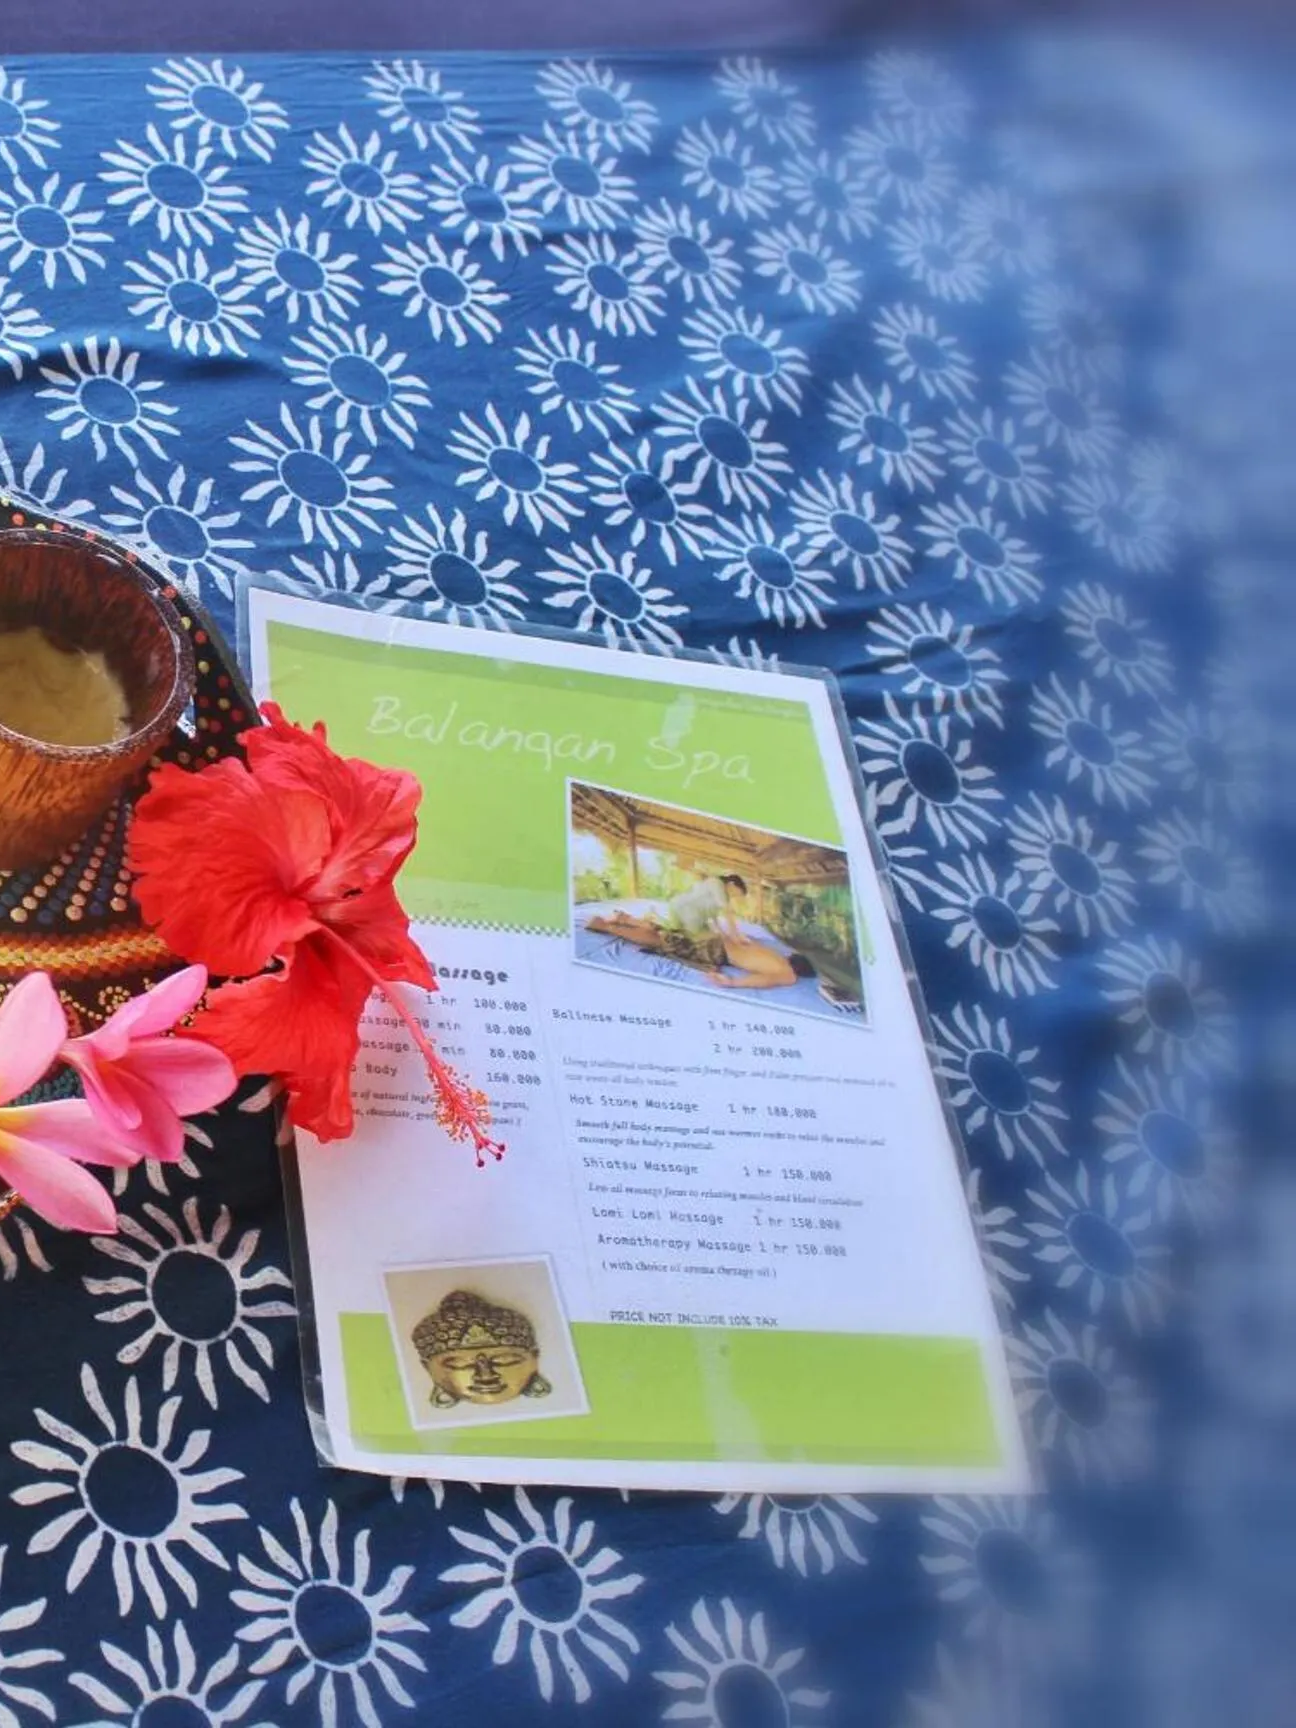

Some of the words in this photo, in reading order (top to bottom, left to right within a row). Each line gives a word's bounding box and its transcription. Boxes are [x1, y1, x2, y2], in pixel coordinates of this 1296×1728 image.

[365, 695, 617, 771] Balangan
[644, 732, 755, 788] Spa
[552, 1009, 613, 1022] Balinese
[619, 1014, 673, 1029] Massage
[359, 1040, 411, 1053] assage
[569, 1094, 594, 1105] Hot
[600, 1095, 638, 1108] Stone
[645, 1099, 700, 1113] Massage
[583, 1157, 637, 1171] Shiatsu
[644, 1160, 699, 1175] Massage
[592, 1206, 624, 1219] Lomi
[632, 1208, 662, 1220] Lomi
[669, 1210, 724, 1226] Massage
[598, 1233, 691, 1251] Aromatherapy
[698, 1238, 751, 1254] Massage
[610, 1309, 645, 1323] PRICE
[649, 1311, 673, 1323] NOT
[677, 1312, 726, 1325] INCLUDE
[755, 1315, 779, 1328] TAX
